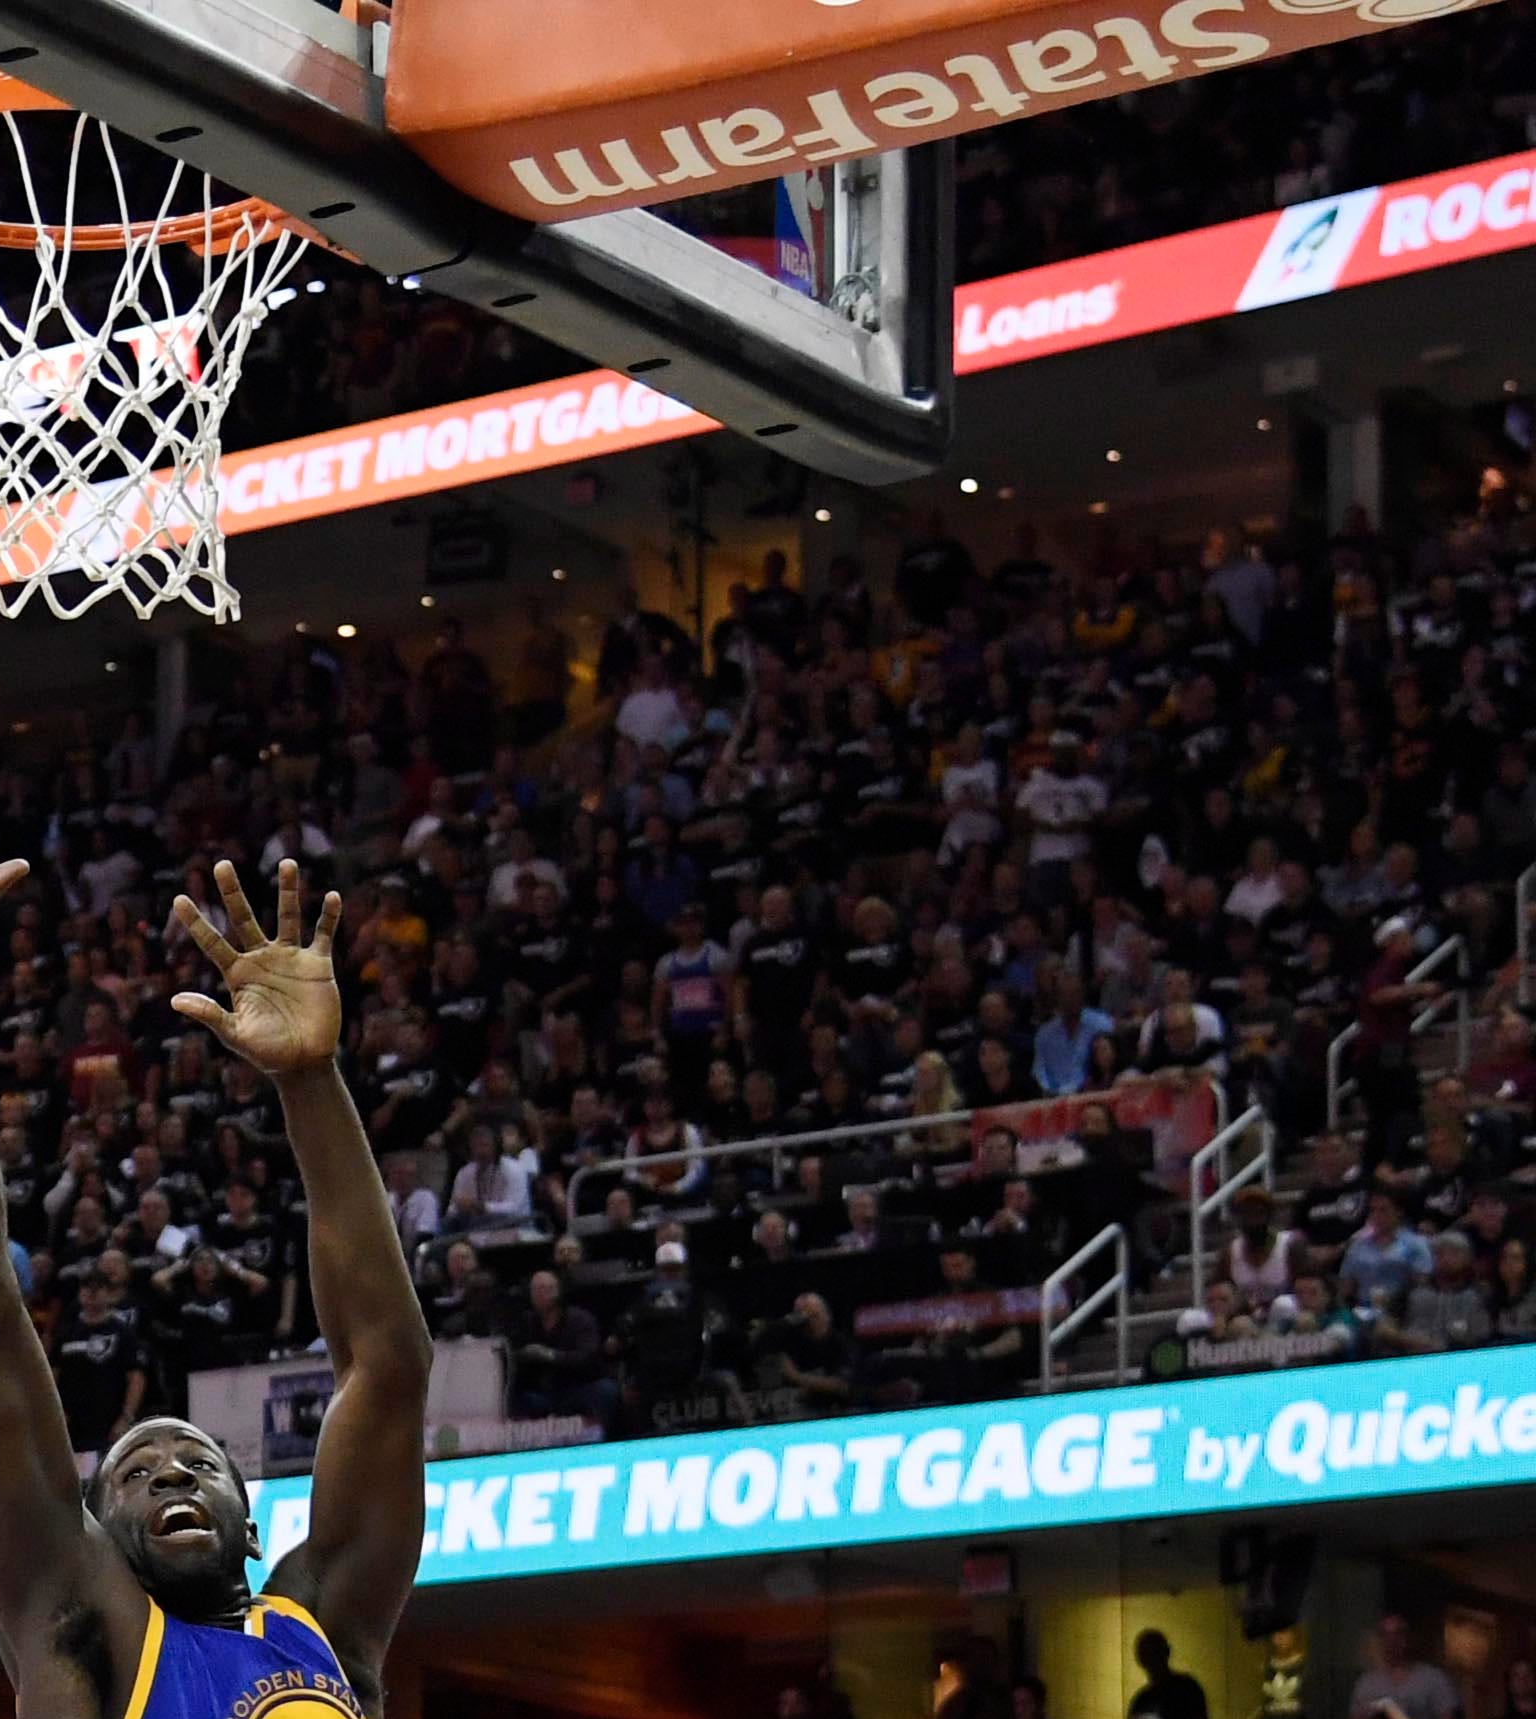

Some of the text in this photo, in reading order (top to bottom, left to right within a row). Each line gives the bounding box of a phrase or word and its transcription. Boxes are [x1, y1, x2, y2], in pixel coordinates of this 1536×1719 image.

[1379, 168, 1536, 257] ROC
[780, 240, 809, 281] NBA
[957, 284, 1117, 355] Loans
[624, 1408, 1166, 1537] MORTGAGE
[1183, 1428, 1261, 1490] by
[1266, 1384, 1536, 1485] Quicke
